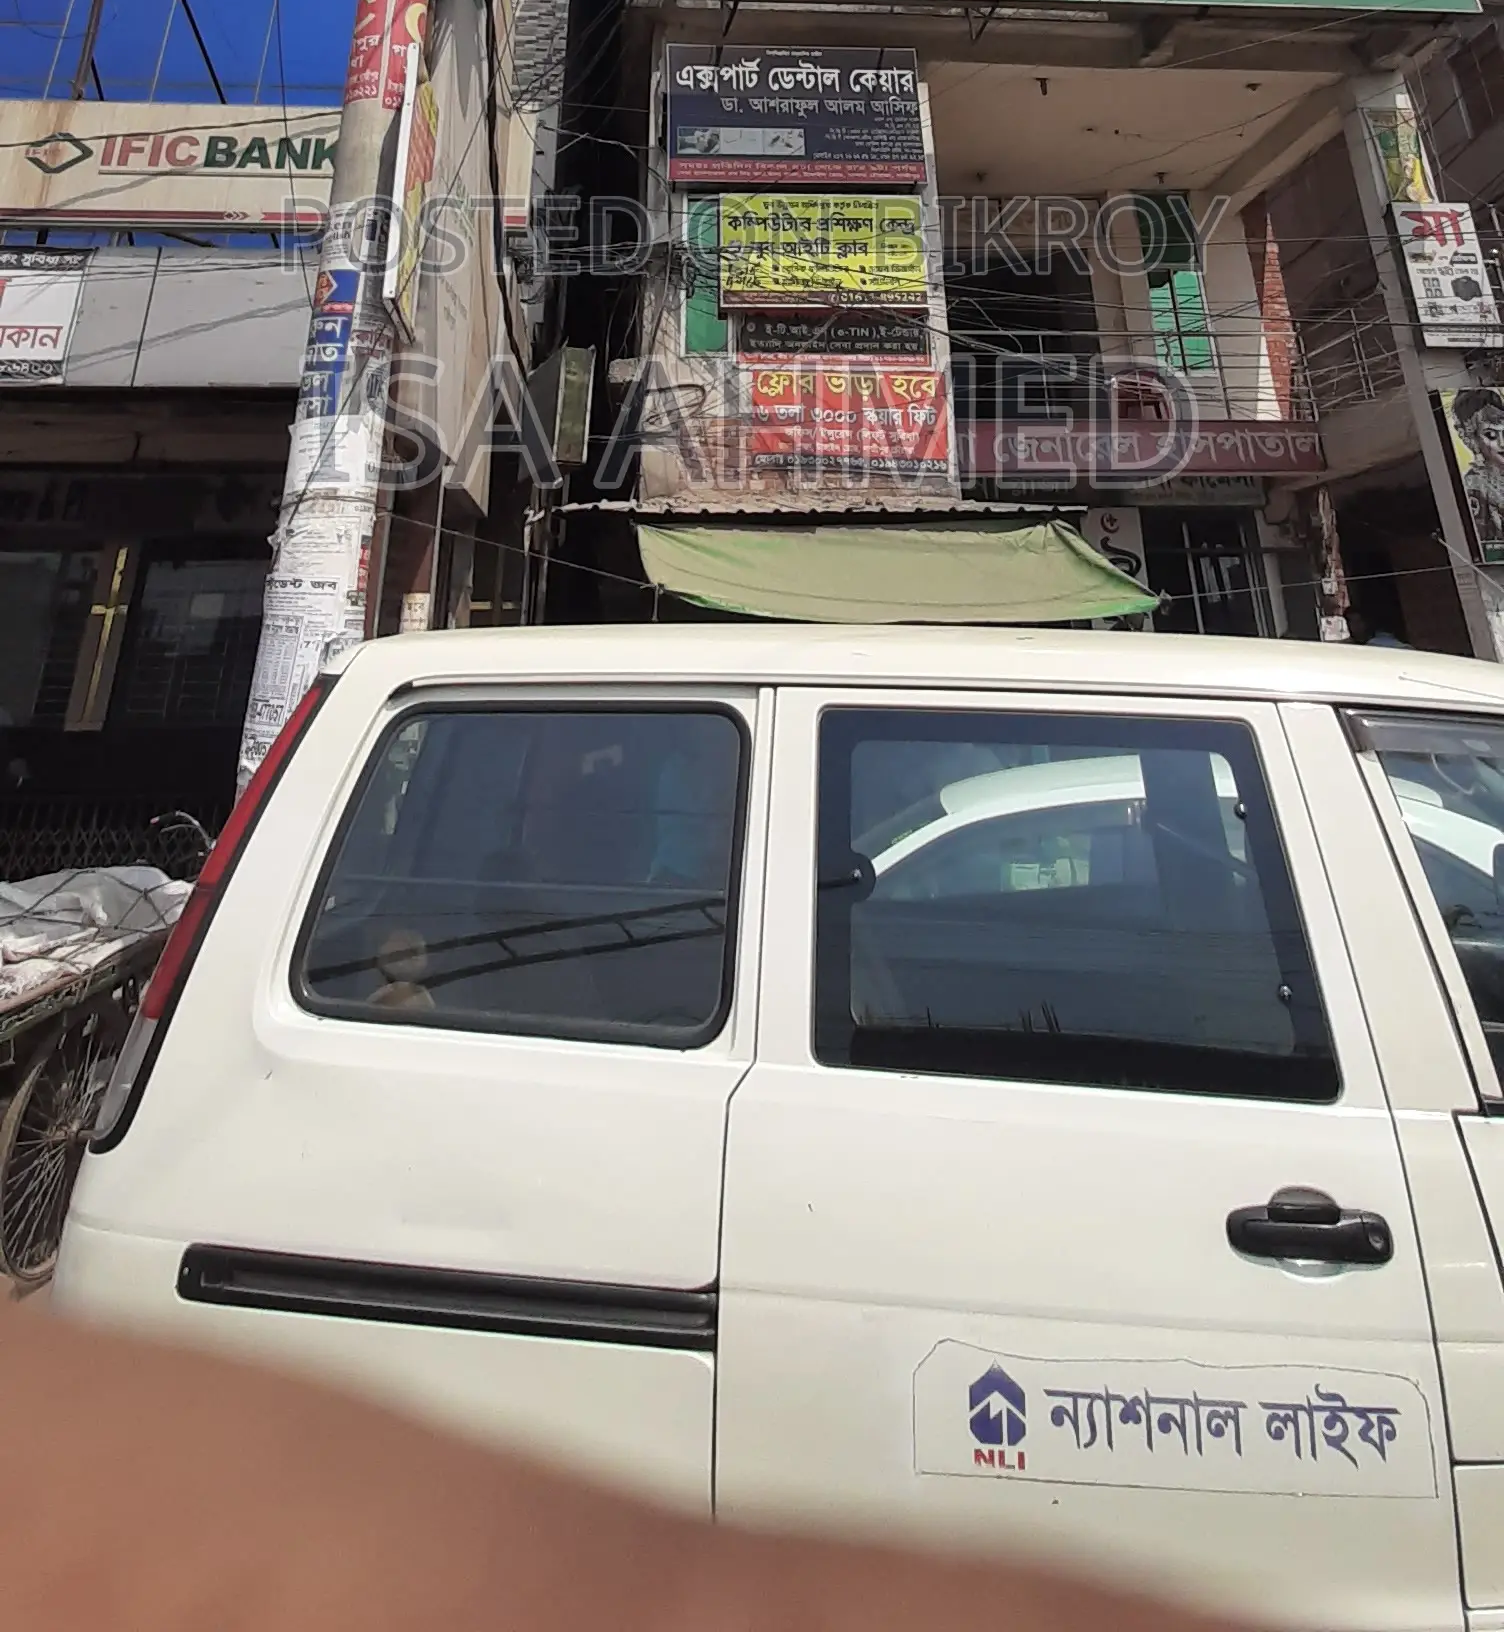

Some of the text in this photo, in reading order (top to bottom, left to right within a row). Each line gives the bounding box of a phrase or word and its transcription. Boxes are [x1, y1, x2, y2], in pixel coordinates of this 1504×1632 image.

[676, 58, 915, 94] এক্সপার্ট ডেন্টাল কেয়ার
[1400, 208, 1466, 248] মা
[825, 372, 882, 402] ভাড়া
[889, 374, 939, 399] হবে
[1150, 428, 1326, 464] হাসপাতাল
[1042, 1383, 1402, 1468] ন্যাশনাল লাইফ
[973, 1447, 1026, 1470] NLI
